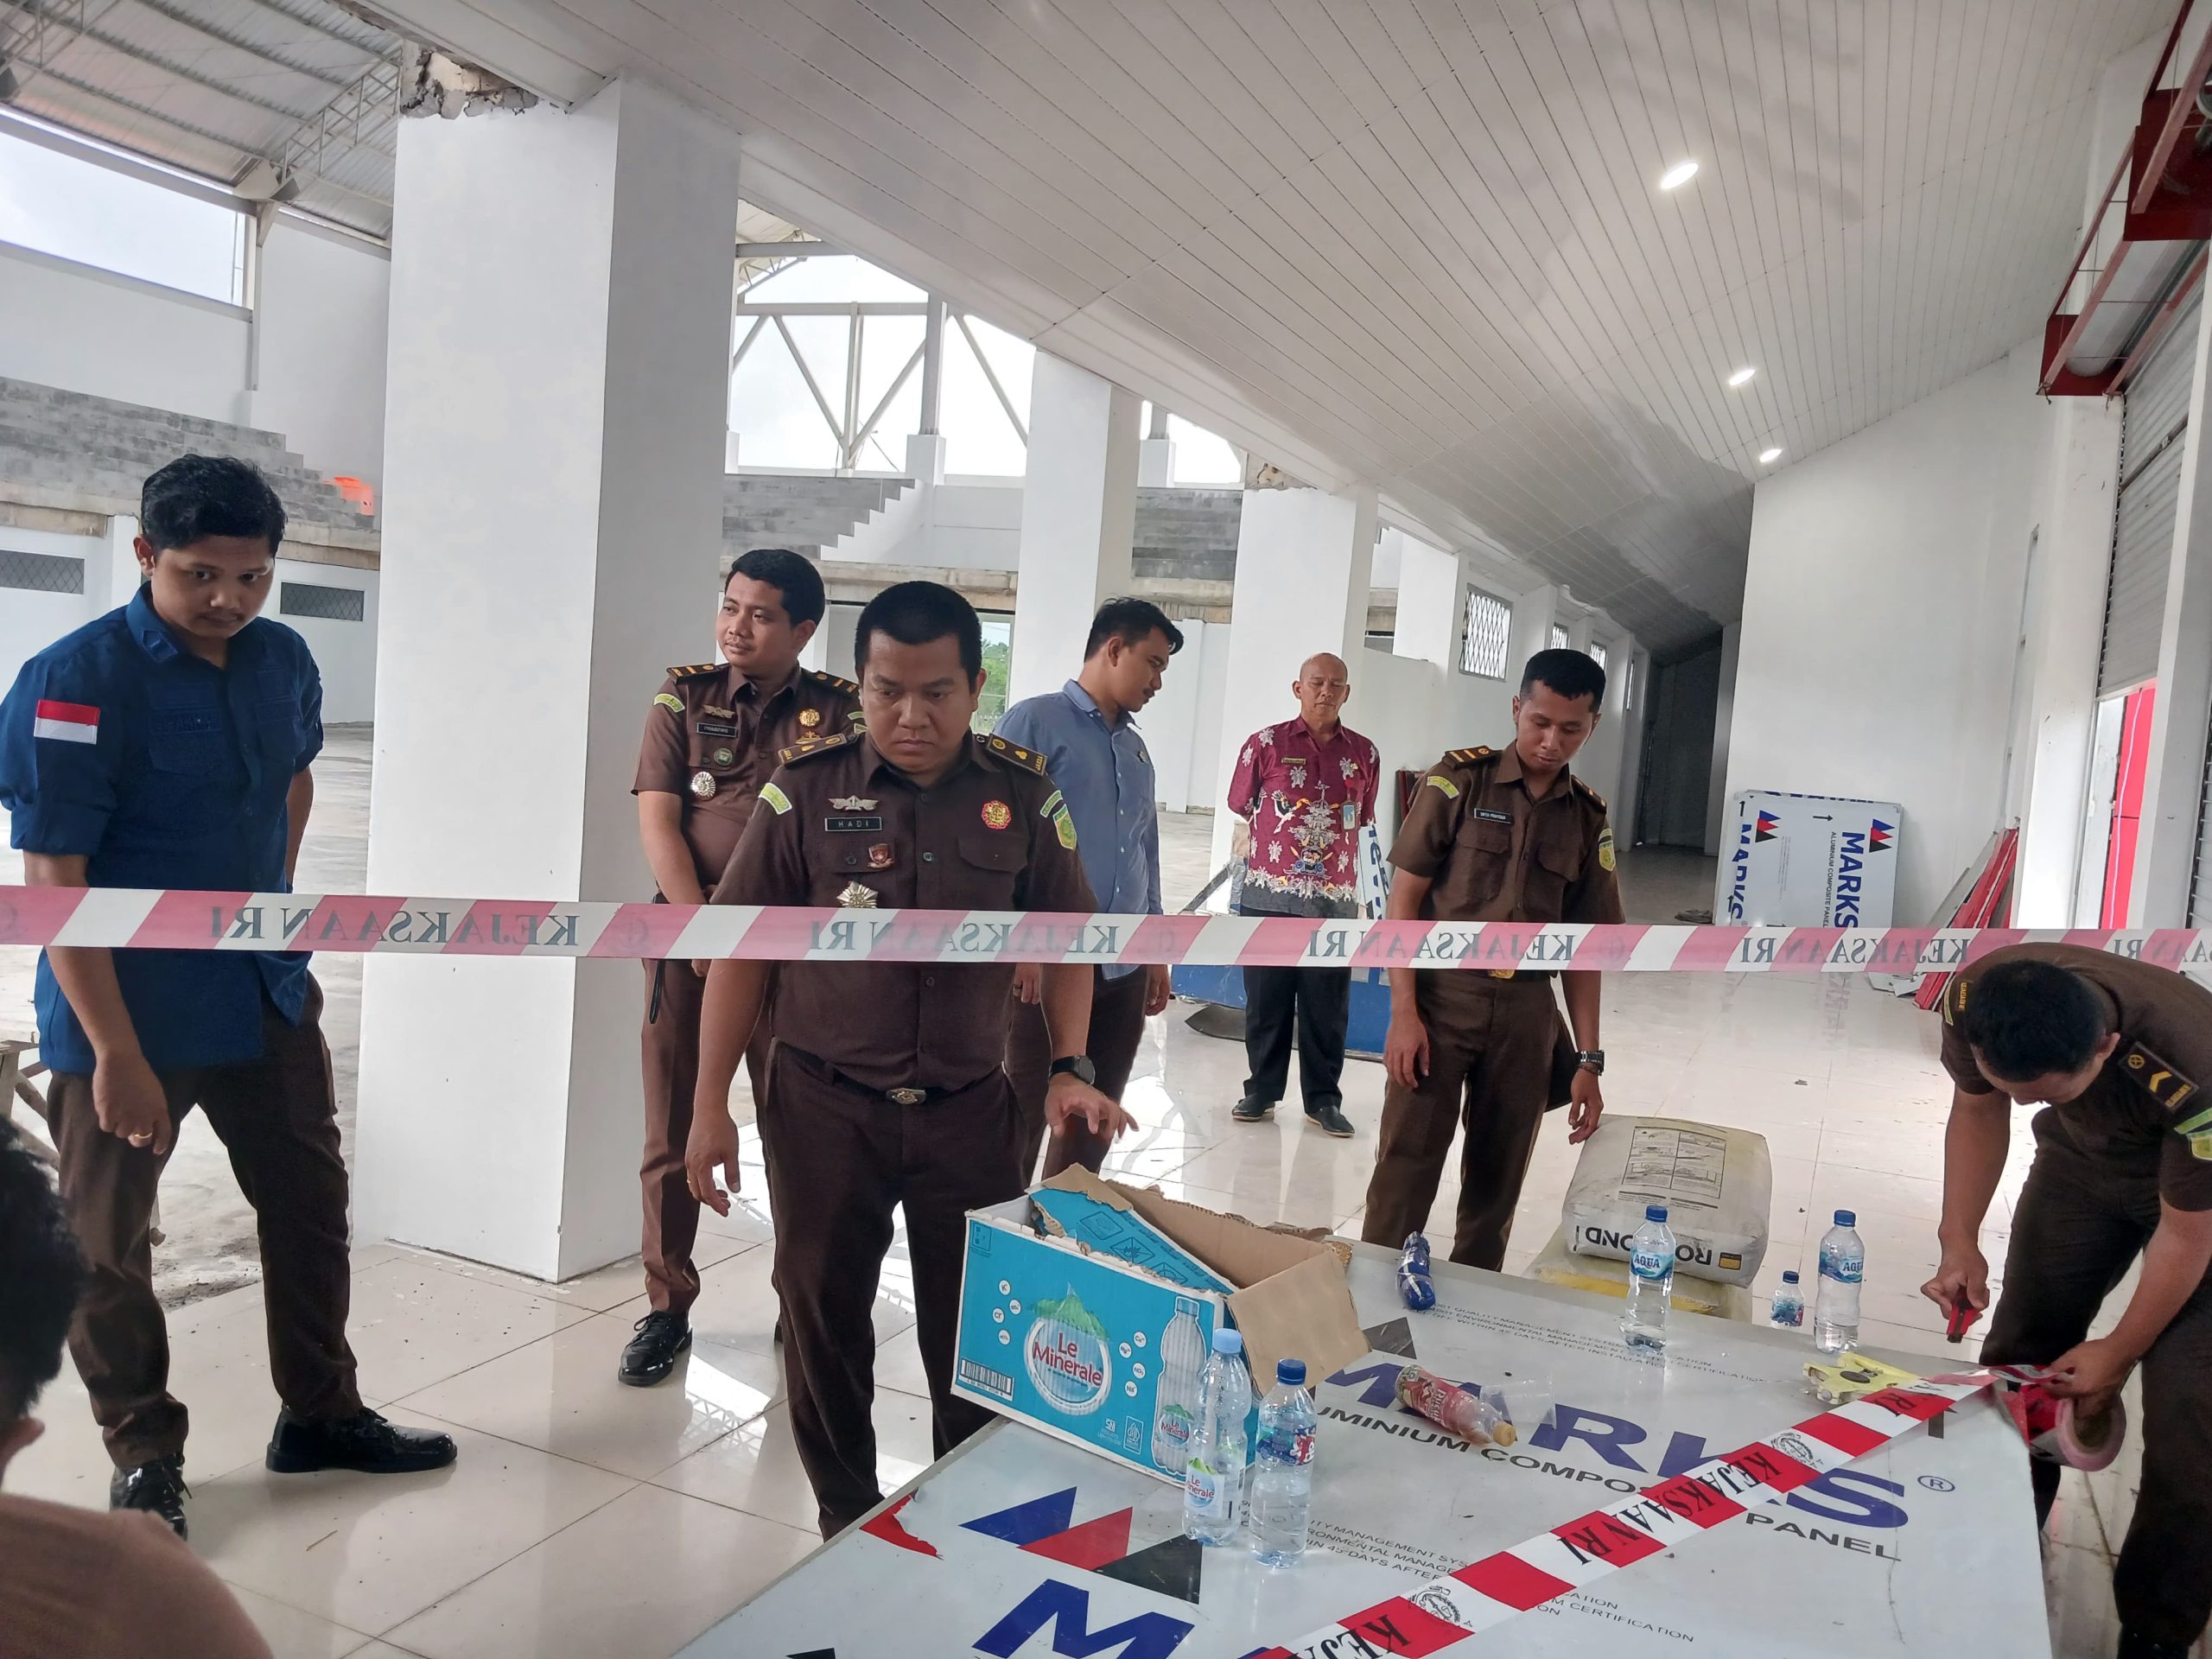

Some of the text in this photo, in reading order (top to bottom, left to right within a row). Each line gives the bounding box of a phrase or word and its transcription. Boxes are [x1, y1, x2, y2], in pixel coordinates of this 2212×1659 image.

[1827, 831, 1837, 868] ALUMINIUM
[1824, 867, 1834, 906] COMPOSITE
[1834, 831, 1866, 928] MARKS
[1634, 1254, 1661, 1269] AQUA
[1058, 1332, 1078, 1358] Le
[1033, 1341, 1103, 1386] Minerale
[1160, 1421, 1190, 1440] Minerale
[1171, 1418, 1179, 1428] Le
[1187, 1482, 1215, 1498] inerale
[1191, 1474, 1201, 1487] Le
[1556, 1451, 1782, 1566] KEJAKSAAN RI
[1333, 1525, 1435, 1558] MANAGEMENT
[1745, 1512, 1902, 1562] PANEL
[1348, 1551, 1388, 1567] DAYS
[1569, 1602, 1694, 1643] CERTIFICATION
